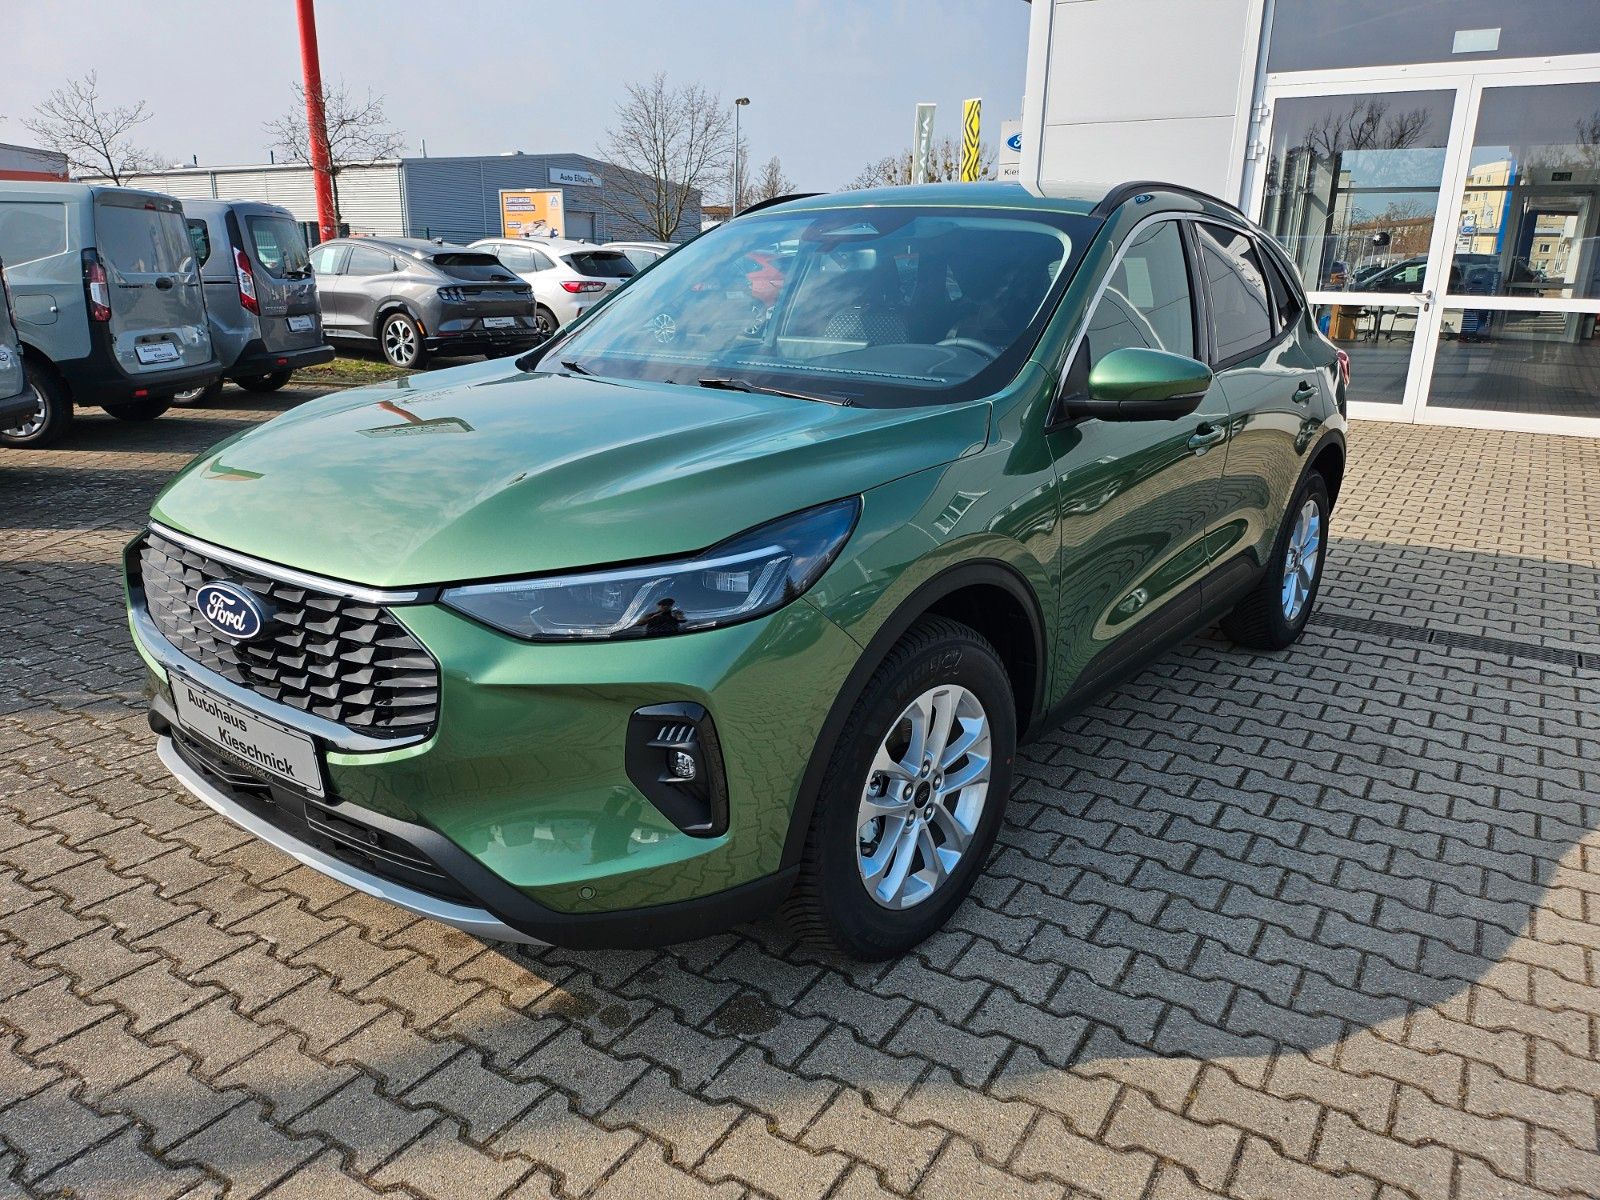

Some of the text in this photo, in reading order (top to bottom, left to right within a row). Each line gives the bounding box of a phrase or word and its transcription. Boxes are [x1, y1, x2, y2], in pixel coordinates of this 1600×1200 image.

[560, 173, 573, 182] Auto
[206, 591, 246, 632] Ford
[187, 688, 248, 732] Autohaus
[218, 726, 295, 777] Kieschnick
